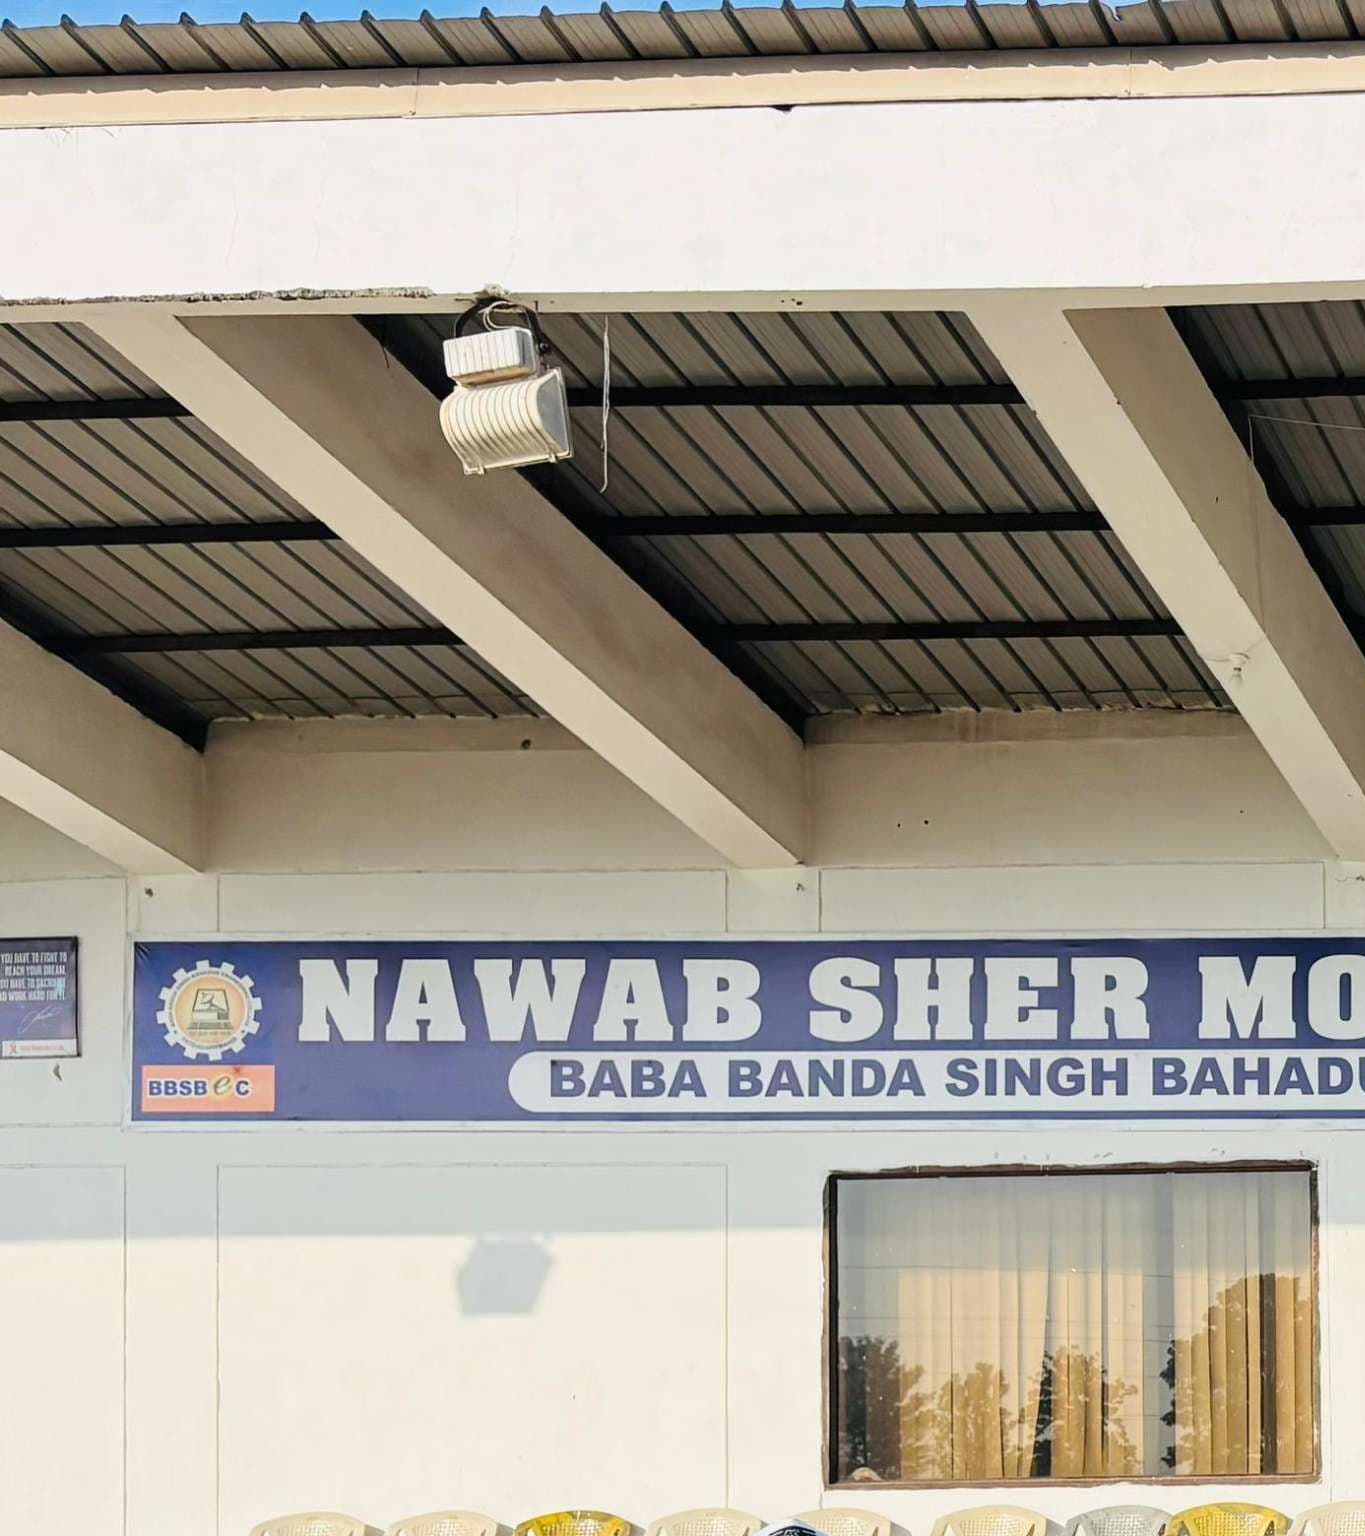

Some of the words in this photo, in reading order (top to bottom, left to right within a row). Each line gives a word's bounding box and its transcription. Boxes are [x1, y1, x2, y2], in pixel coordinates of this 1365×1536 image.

[298, 957, 763, 1043] NAWAB
[808, 954, 1151, 1043] SHER
[549, 1058, 707, 1099] BABA
[727, 1058, 925, 1098] BANDA
[944, 1056, 1128, 1098] SINGH
